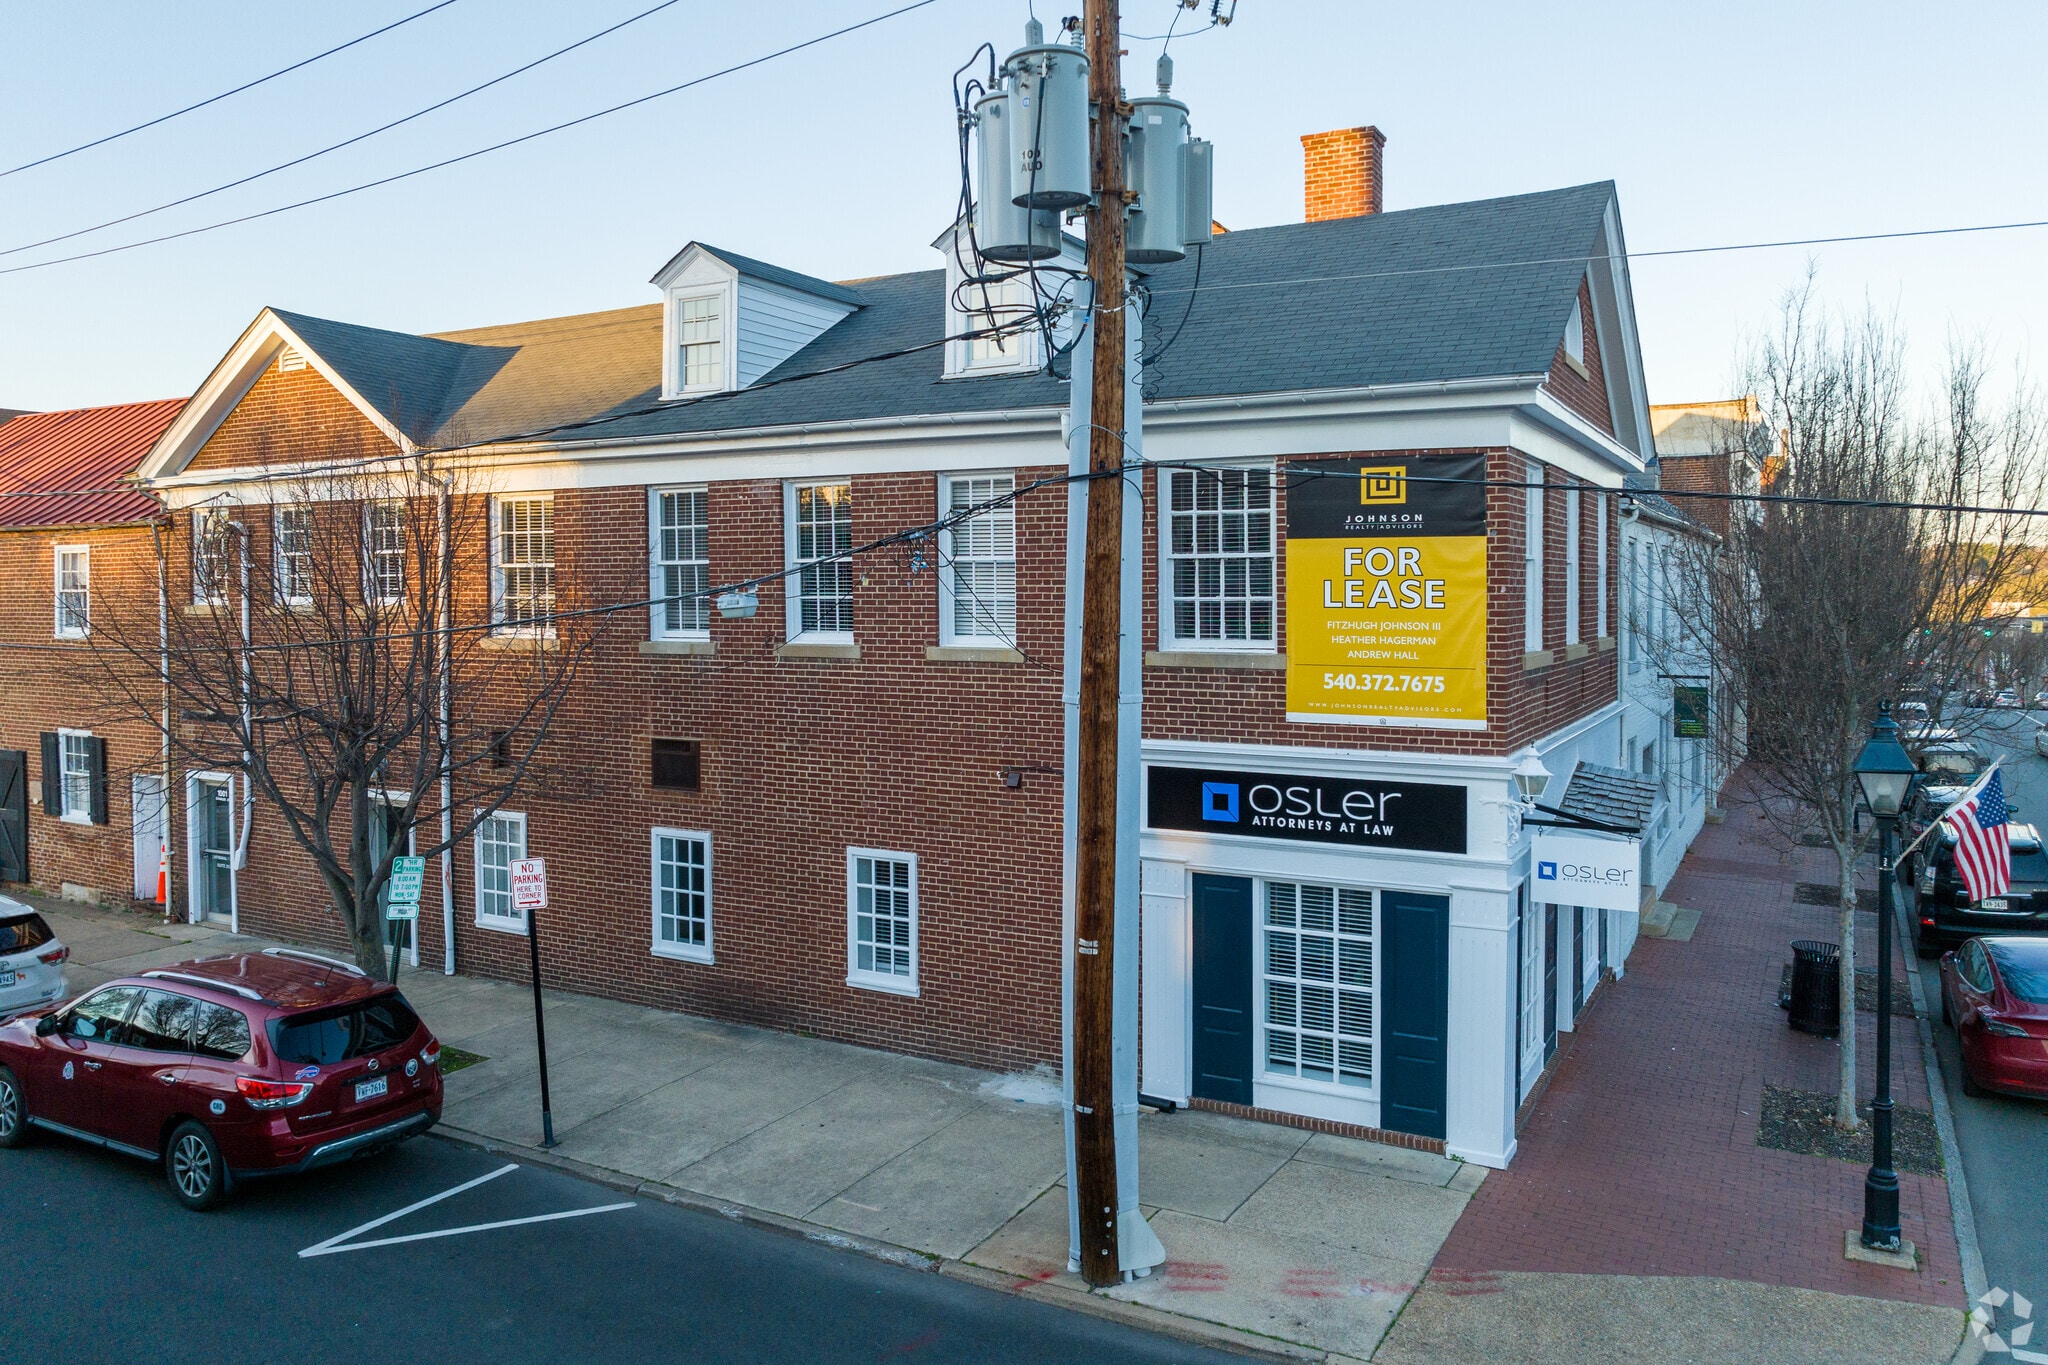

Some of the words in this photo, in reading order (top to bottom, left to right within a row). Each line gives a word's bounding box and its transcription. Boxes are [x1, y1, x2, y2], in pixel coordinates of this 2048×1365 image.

[1345, 513, 1423, 523] JOHNSON
[1343, 546, 1424, 577] FOR
[1323, 579, 1446, 609] LEASE
[1327, 620, 1378, 630] FITZHUGH
[1379, 621, 1430, 632] JOHNSON
[1431, 622, 1441, 631] III
[1331, 635, 1377, 645] HEATHER
[1379, 636, 1437, 646] HAGERMAN
[1347, 650, 1391, 659] ANDREW
[1393, 651, 1420, 660] HALL
[1323, 673, 1446, 693] 540.372.7675
[1252, 815, 1332, 832] ATTORNEYS
[1339, 821, 1356, 834] AT
[1364, 823, 1395, 836] LAW
[394, 860, 403, 872] 2
[521, 863, 535, 873] NO
[513, 873, 544, 885] PARKING
[516, 885, 532, 893] HERE
[534, 884, 542, 892] TO
[517, 891, 542, 900] CORNER
